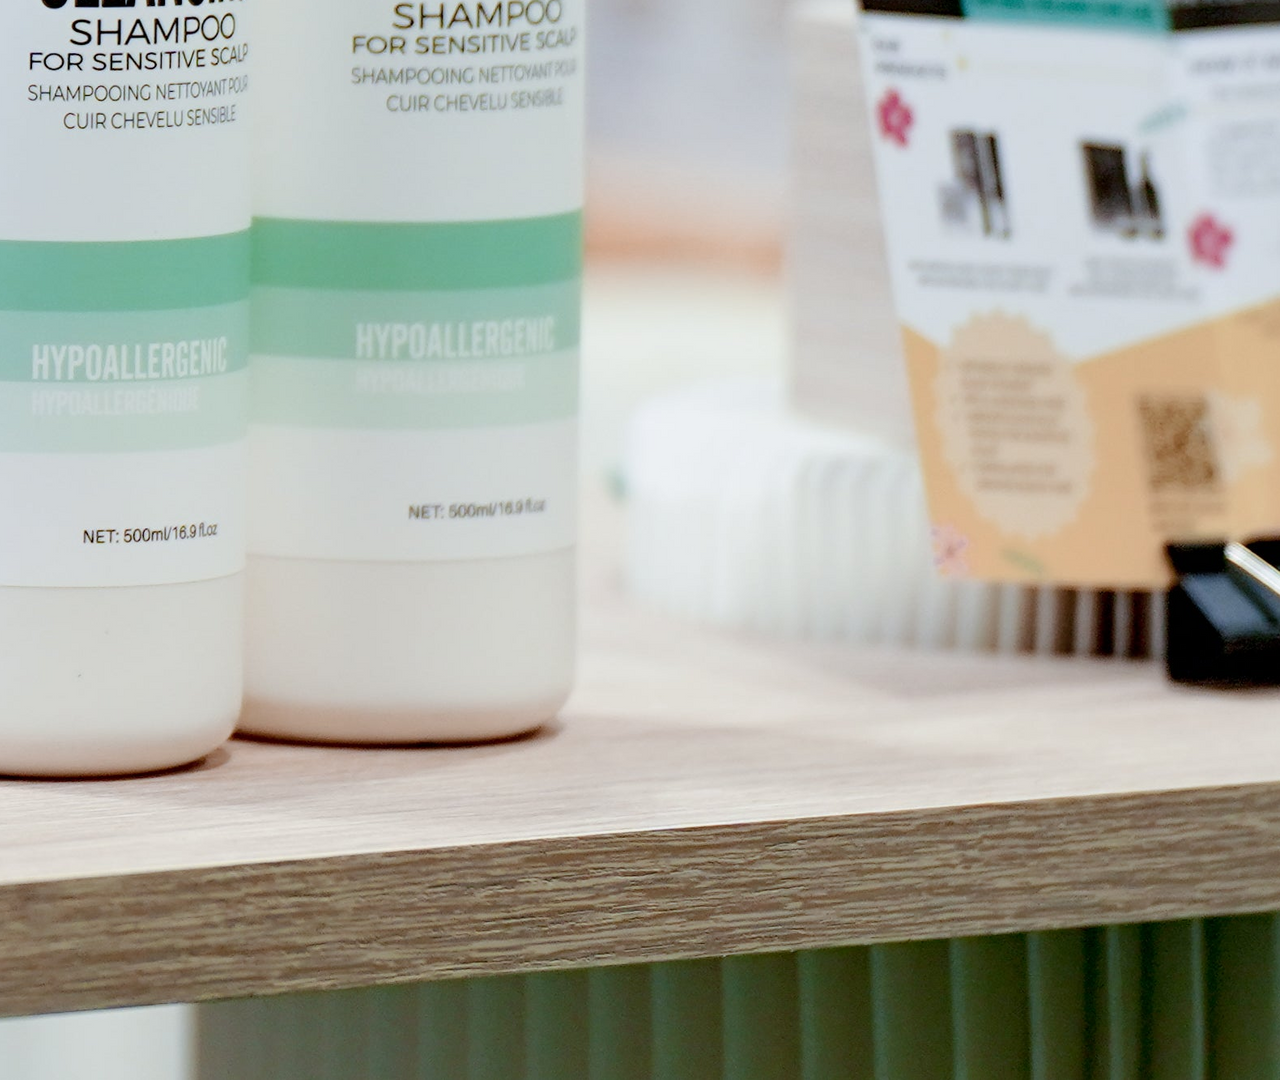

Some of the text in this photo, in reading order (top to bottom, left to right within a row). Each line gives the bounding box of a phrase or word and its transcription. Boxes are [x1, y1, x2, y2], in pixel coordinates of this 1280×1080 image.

[70, 13, 236, 46] SHAMPOO
[352, 27, 576, 55] FOR SENSITIVE SCALP
[28, 44, 248, 72] FOR SENSITIVE SCALP
[351, 66, 474, 86] SHAMPOOING
[478, 63, 552, 84] NETTOYANT
[27, 76, 248, 102] SHAMPOOING NETTOYANT POUR
[386, 86, 564, 113] CUIR CHEVELU SENSIBLE
[63, 105, 236, 130] CUIR CHEVELU SENSIBLE
[355, 317, 554, 360] HYPOALLERGENIC
[32, 337, 228, 382] HYPOALLERGENIC
[32, 386, 199, 417] HYPOALLERGÉNIQUE
[408, 503, 443, 520] NET:
[82, 529, 120, 545] NET:
[123, 524, 197, 545] 500ml/16.9
